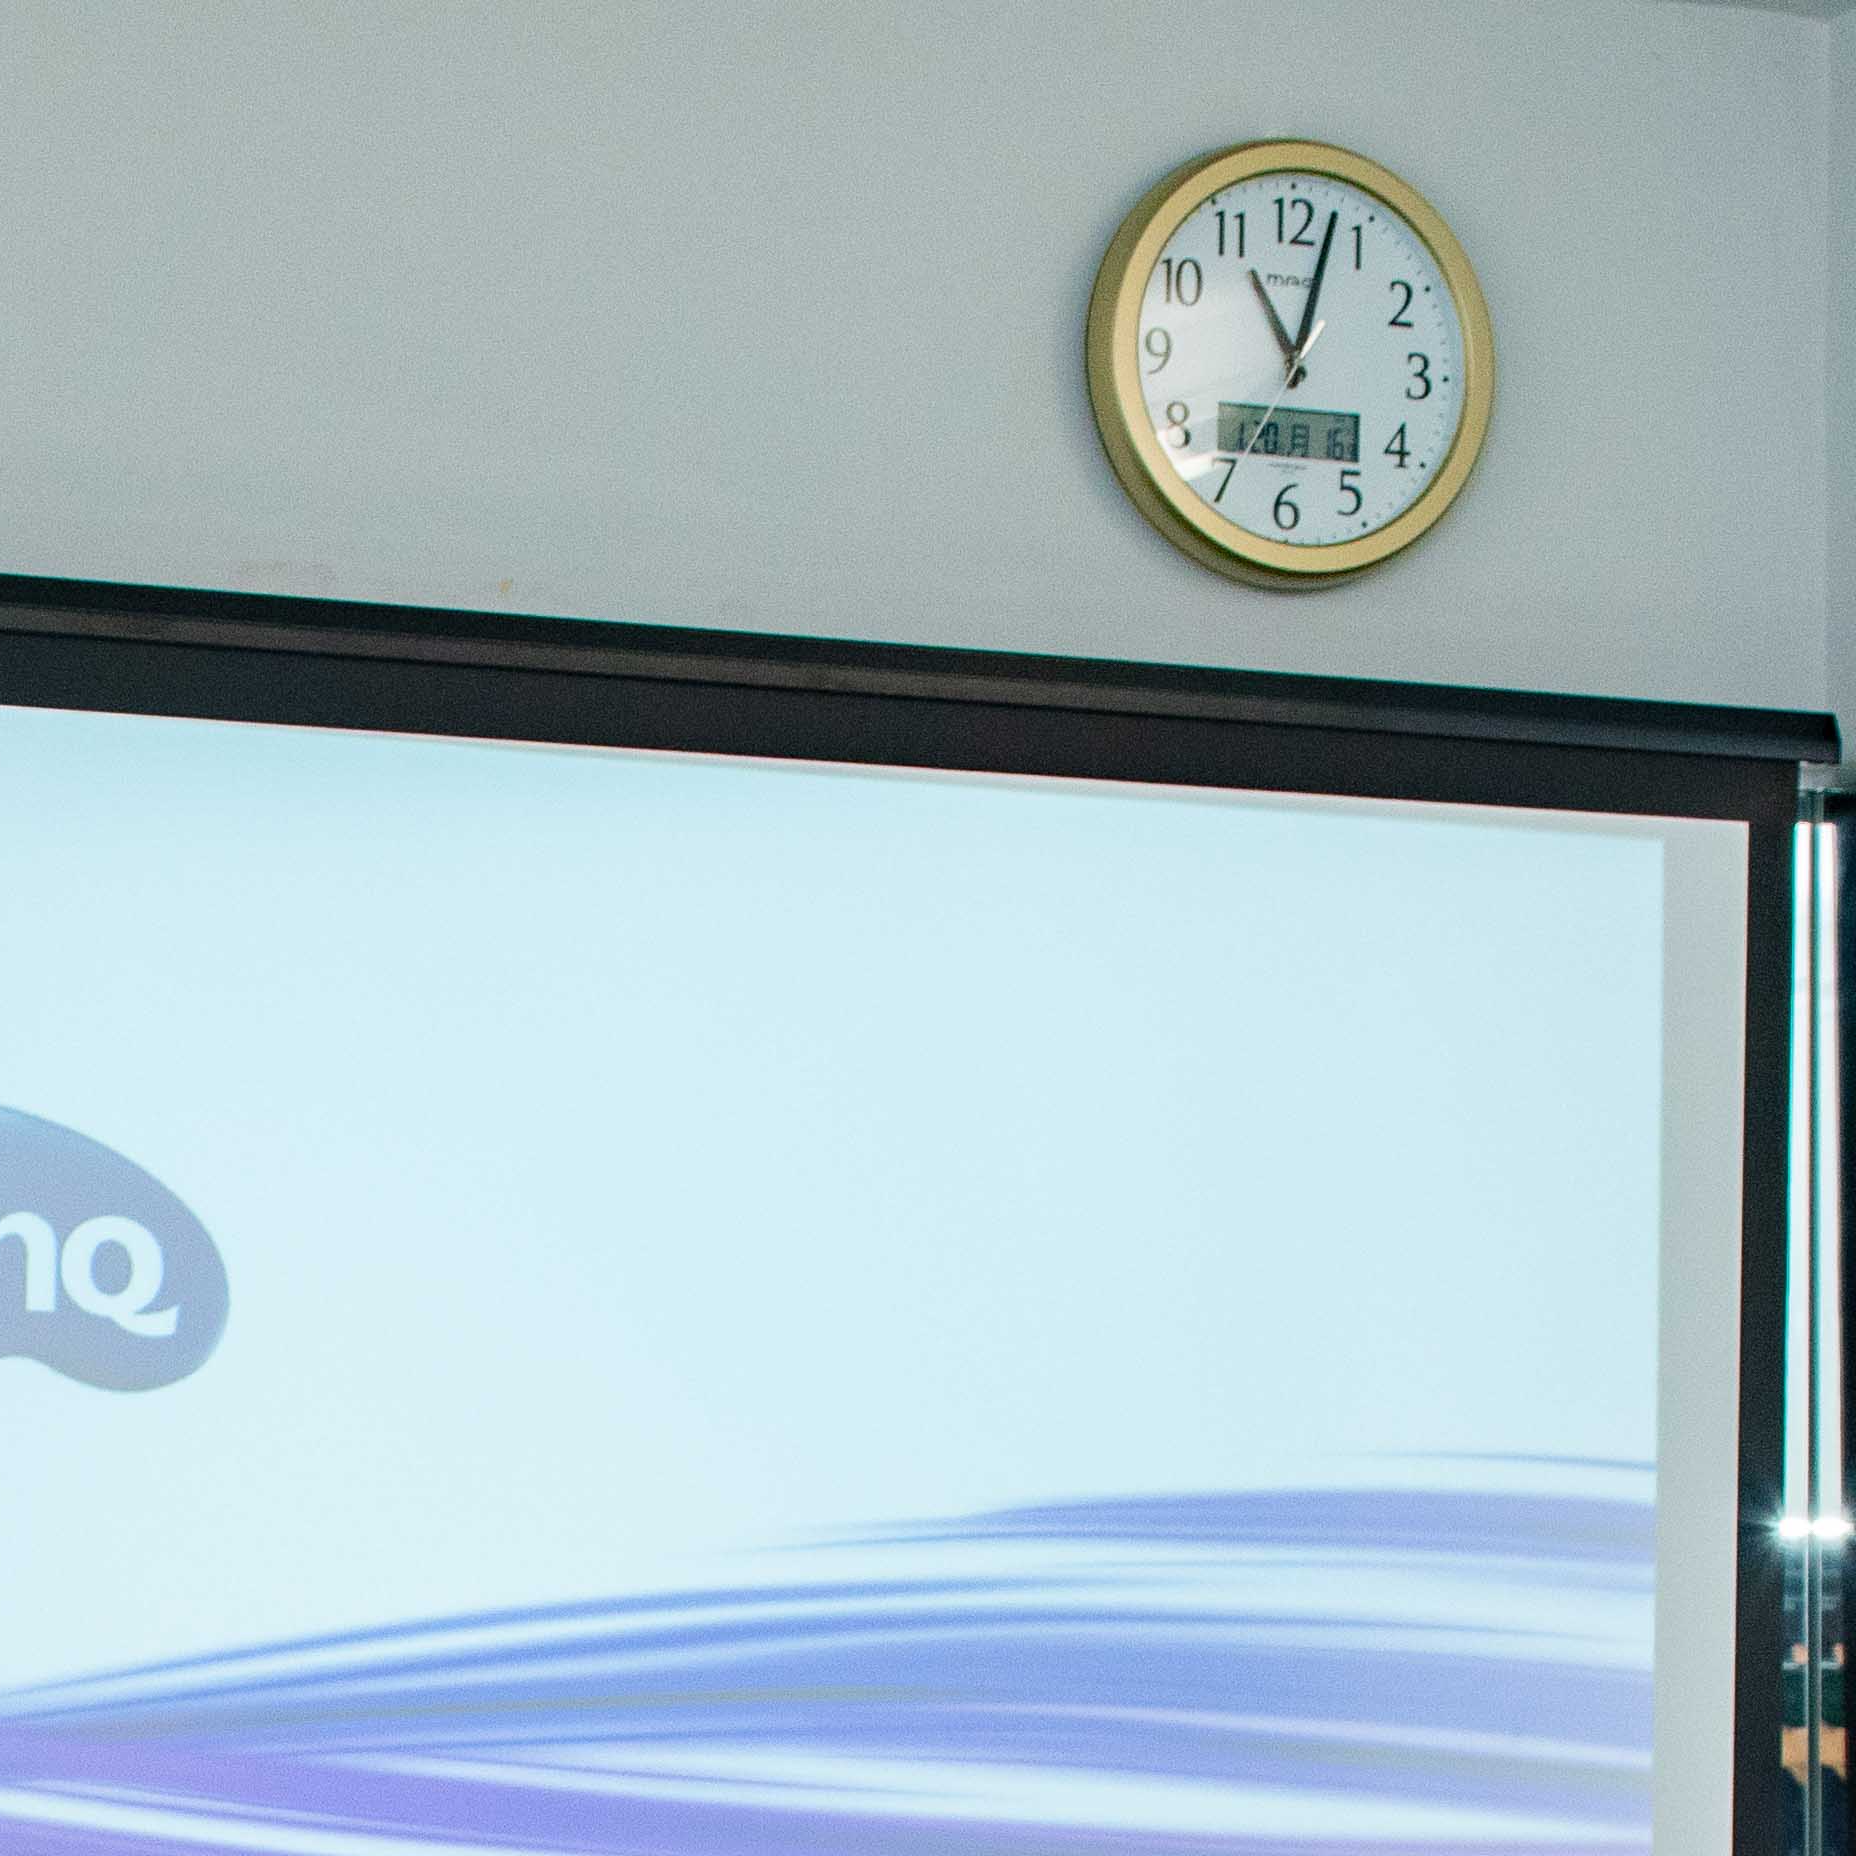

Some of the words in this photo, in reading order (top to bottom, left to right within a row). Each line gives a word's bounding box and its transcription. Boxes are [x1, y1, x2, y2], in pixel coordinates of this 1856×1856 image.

[1215, 209, 1247, 258] 11
[1274, 197, 1316, 247] 12
[1351, 224, 1363, 270] 1
[1161, 257, 1202, 307] 10
[1388, 280, 1415, 328] 2
[1145, 327, 1172, 375] 9
[1405, 352, 1432, 401] 3
[1166, 401, 1191, 449] 8
[1384, 421, 1412, 468] 4
[1211, 458, 1237, 503] 7
[1337, 470, 1363, 515] 5
[1273, 483, 1301, 530] 6
